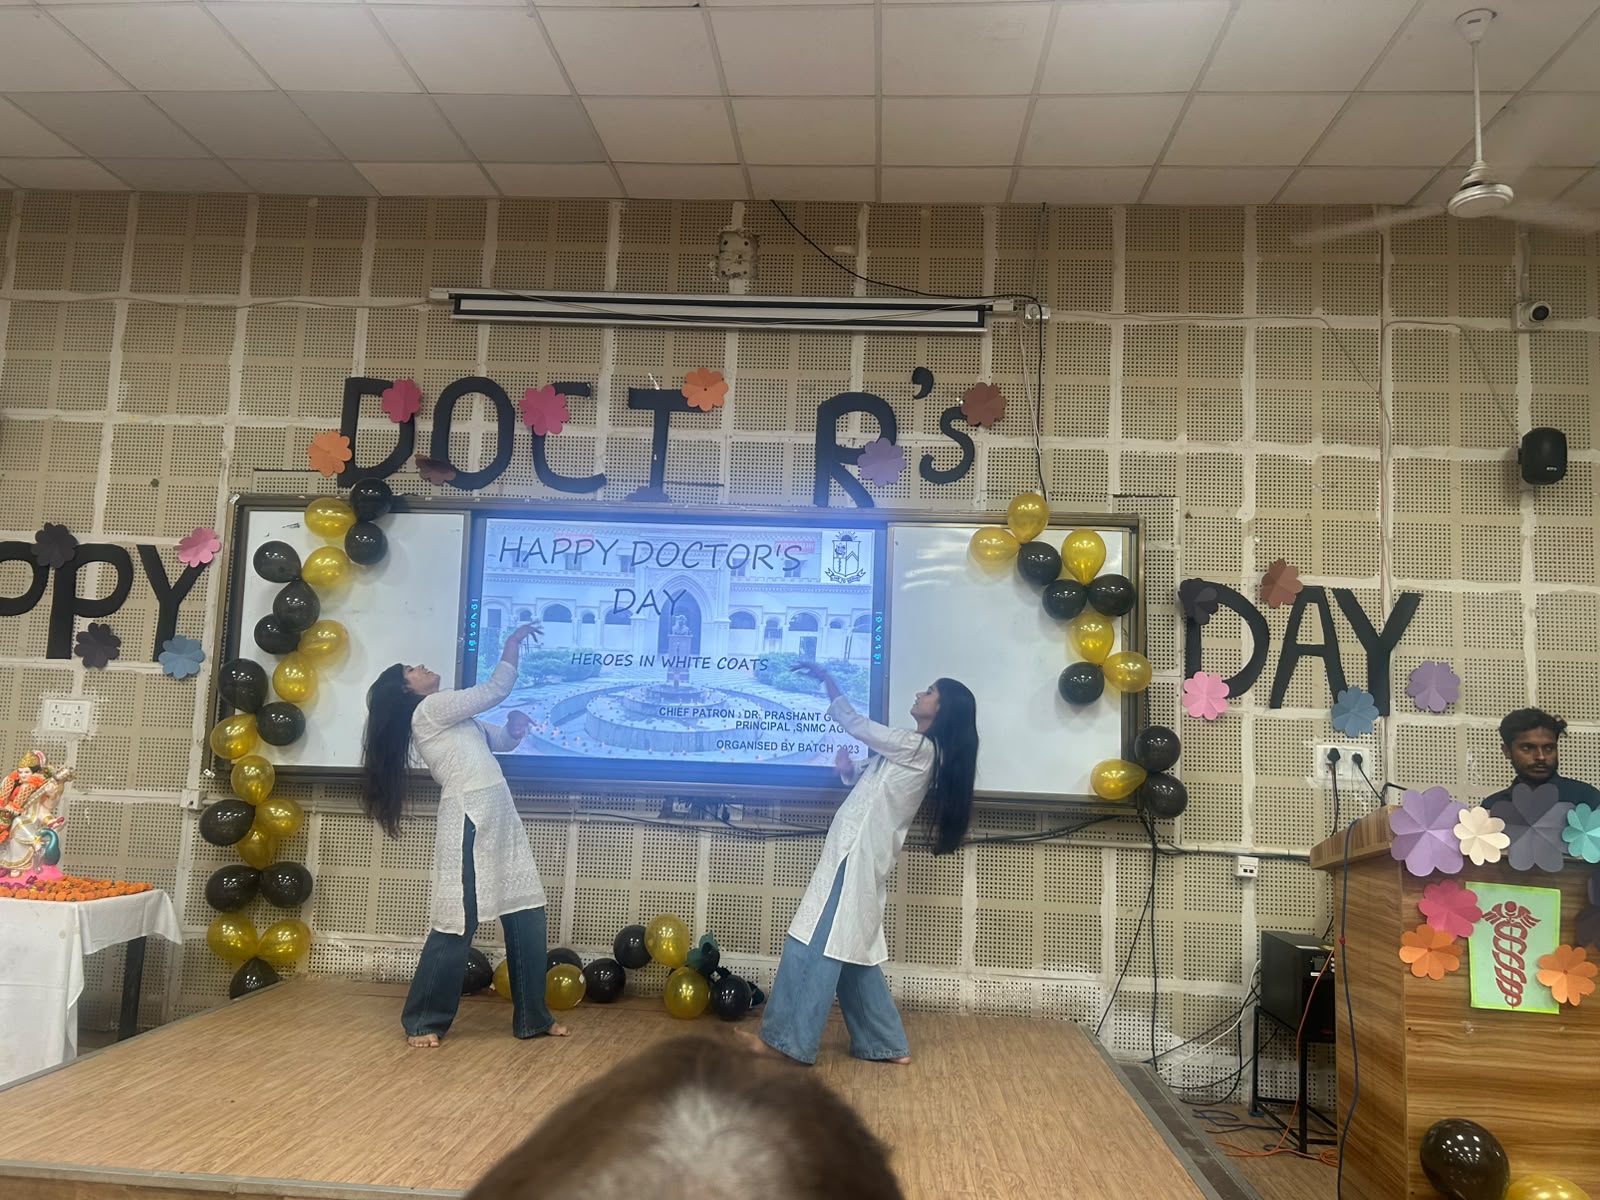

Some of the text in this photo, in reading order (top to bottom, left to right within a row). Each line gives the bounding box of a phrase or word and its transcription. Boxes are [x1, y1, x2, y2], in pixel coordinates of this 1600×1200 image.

[499, 535, 619, 566] HAPPY
[630, 540, 802, 573] DOCTOR'S
[613, 588, 687, 616] DAY
[1184, 580, 1424, 717] DAY
[571, 653, 769, 672] HEROES IN WHITE COATS
[659, 707, 690, 717] CHIEF
[692, 708, 735, 719] PATRON
[764, 711, 821, 722] PRASHANT
[736, 721, 791, 732] PRINCIPAL
[829, 724, 847, 734] AG
[716, 739, 778, 751] ORGANISED
[781, 742, 795, 752] BY
[798, 742, 834, 753] BATCH
